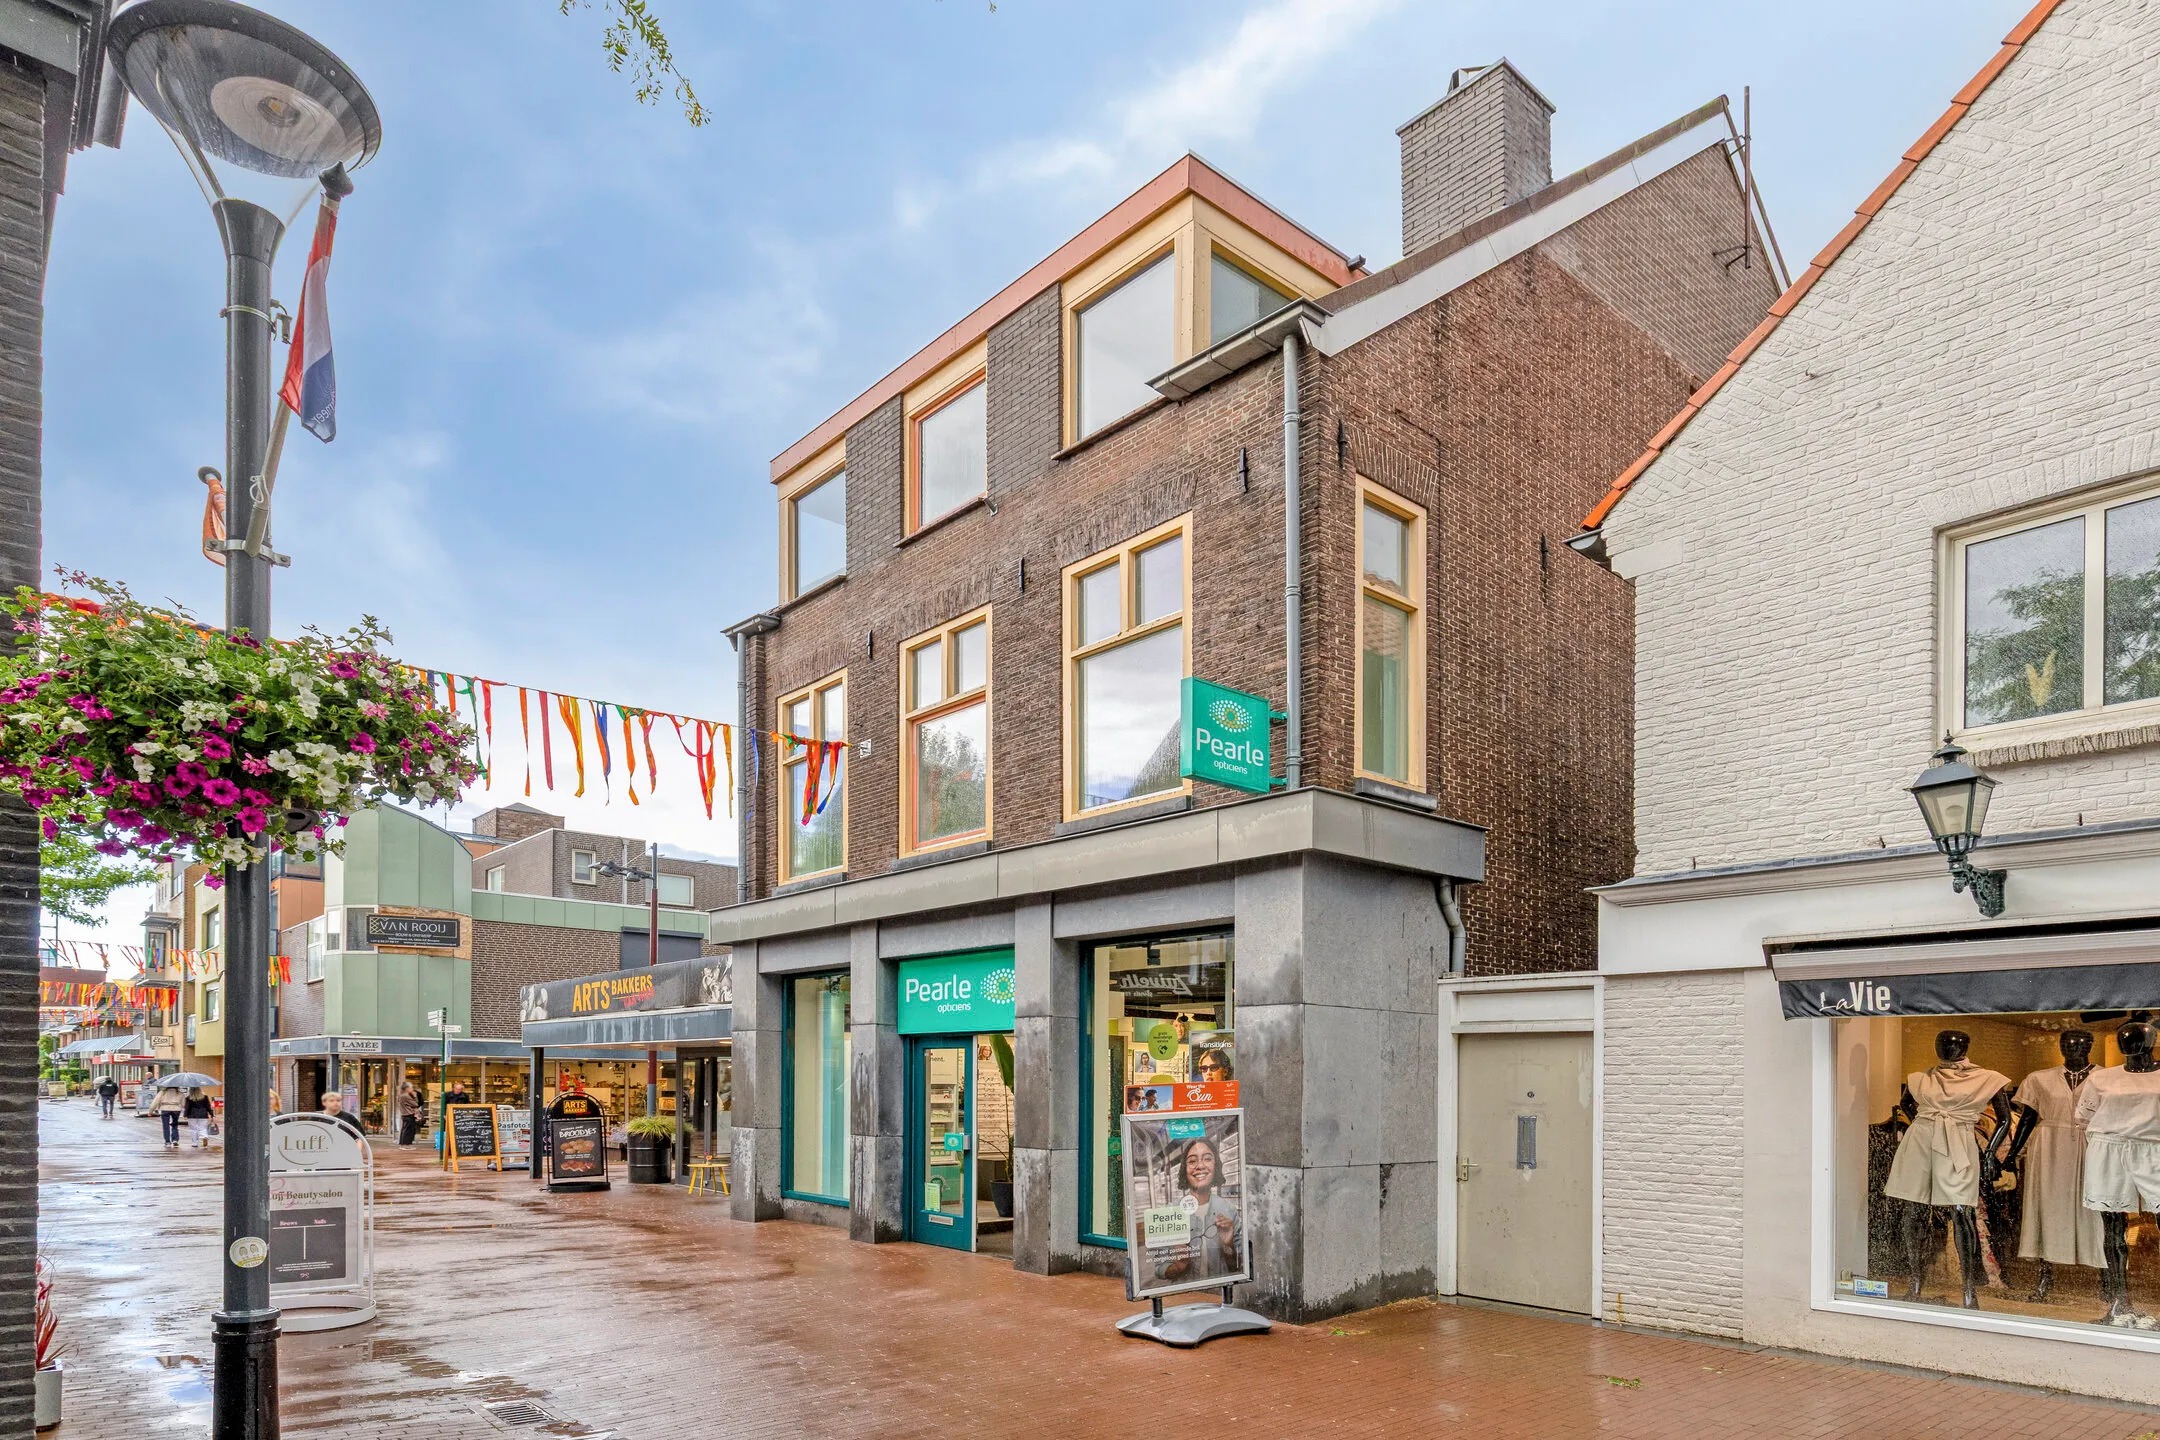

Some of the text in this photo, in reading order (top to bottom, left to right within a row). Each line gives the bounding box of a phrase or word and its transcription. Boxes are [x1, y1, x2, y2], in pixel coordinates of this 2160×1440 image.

[1196, 727, 1264, 767] Pearle
[1214, 760, 1248, 774] opticiens
[380, 921, 446, 933] VAN ROOIJ
[572, 980, 610, 1013] ARTS
[611, 974, 653, 996] BAKKERS
[905, 974, 972, 1003] Pearle
[937, 1002, 972, 1014] opticiens
[153, 1036, 168, 1044] Etos
[1186, 1087, 1213, 1102] Sun
[559, 1127, 597, 1138] BROODJES
[286, 1189, 343, 1200] Beautysalon
[1152, 1212, 1182, 1222] Pearle
[1148, 1223, 1187, 1234] Bril Plan
